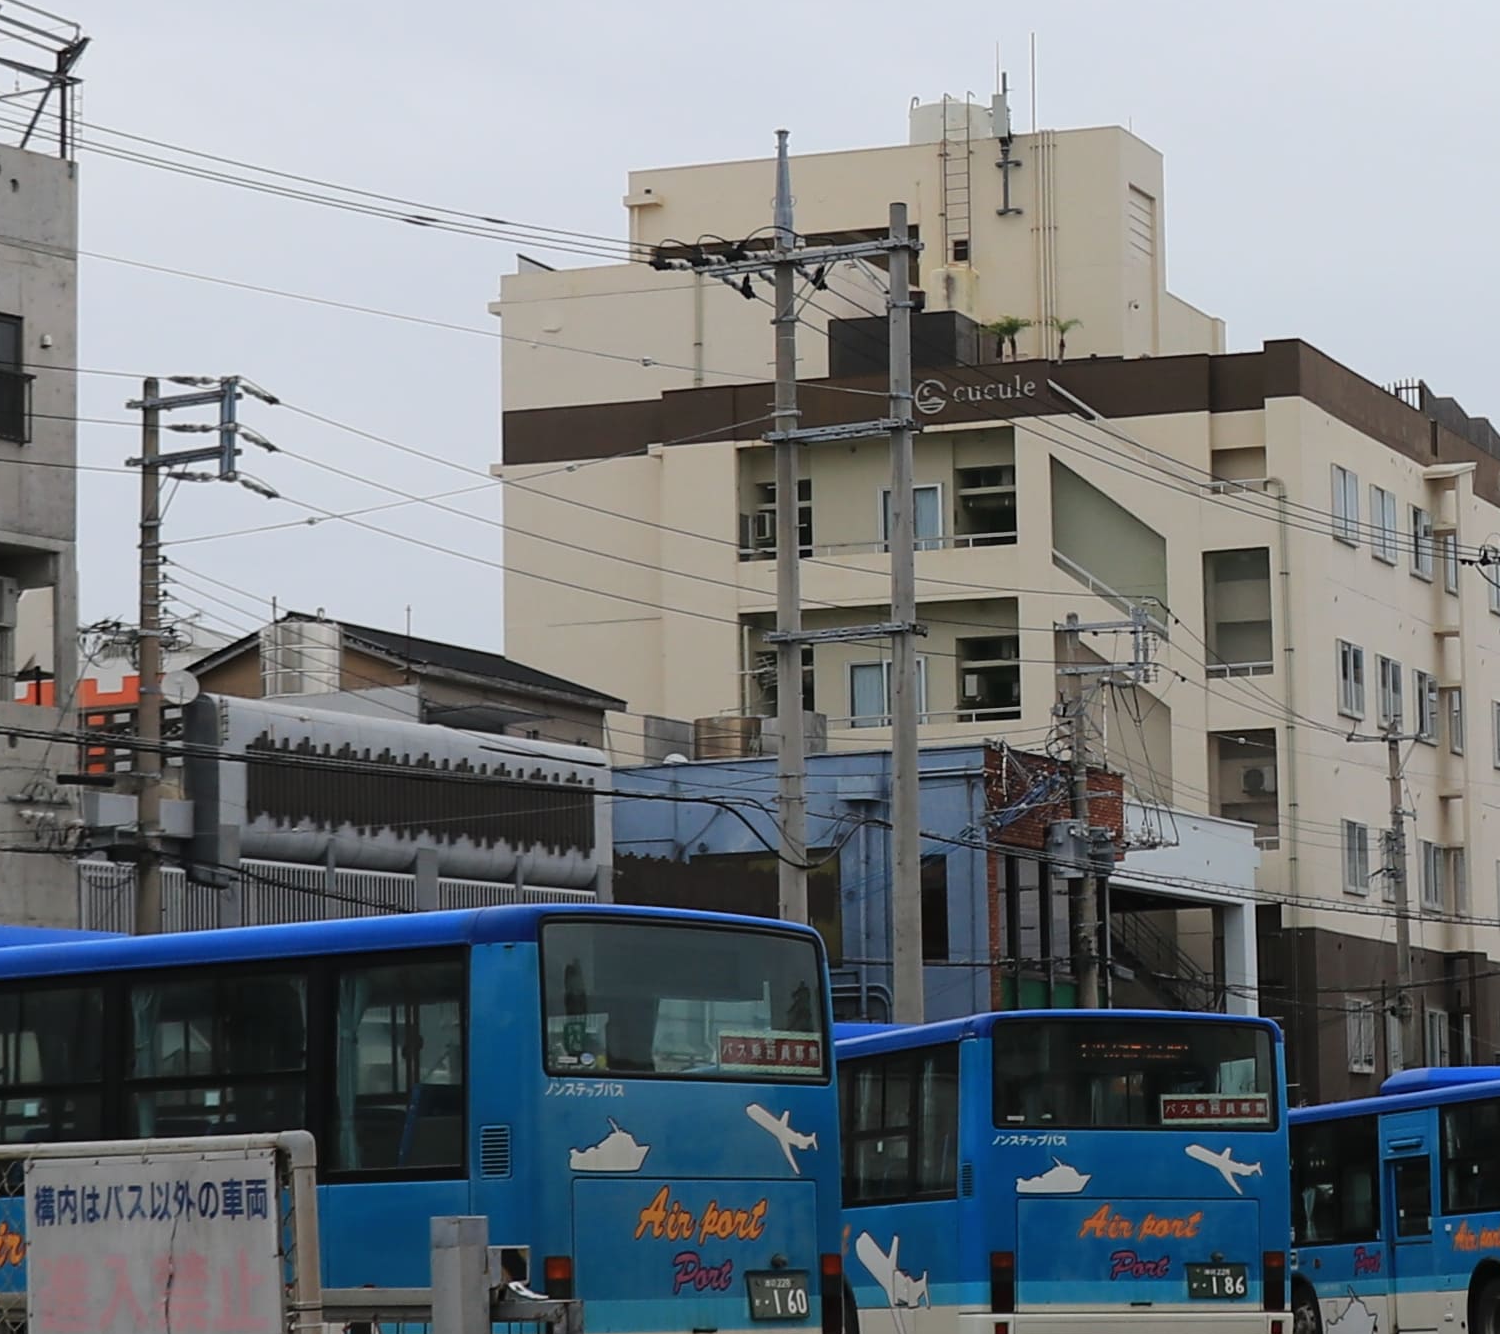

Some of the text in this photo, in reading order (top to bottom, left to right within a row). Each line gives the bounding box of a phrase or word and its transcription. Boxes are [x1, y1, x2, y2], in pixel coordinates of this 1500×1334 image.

[953, 375, 1036, 402] cucule
[545, 1082, 625, 1098] ノンステップバス
[992, 1135, 1067, 1147] ノンステップバス
[34, 1178, 268, 1227] 構内はバス以外の車両
[634, 1184, 768, 1247] Air port
[1078, 1203, 1204, 1241] Air port
[673, 1250, 734, 1295] Port
[1110, 1250, 1170, 1281] Port
